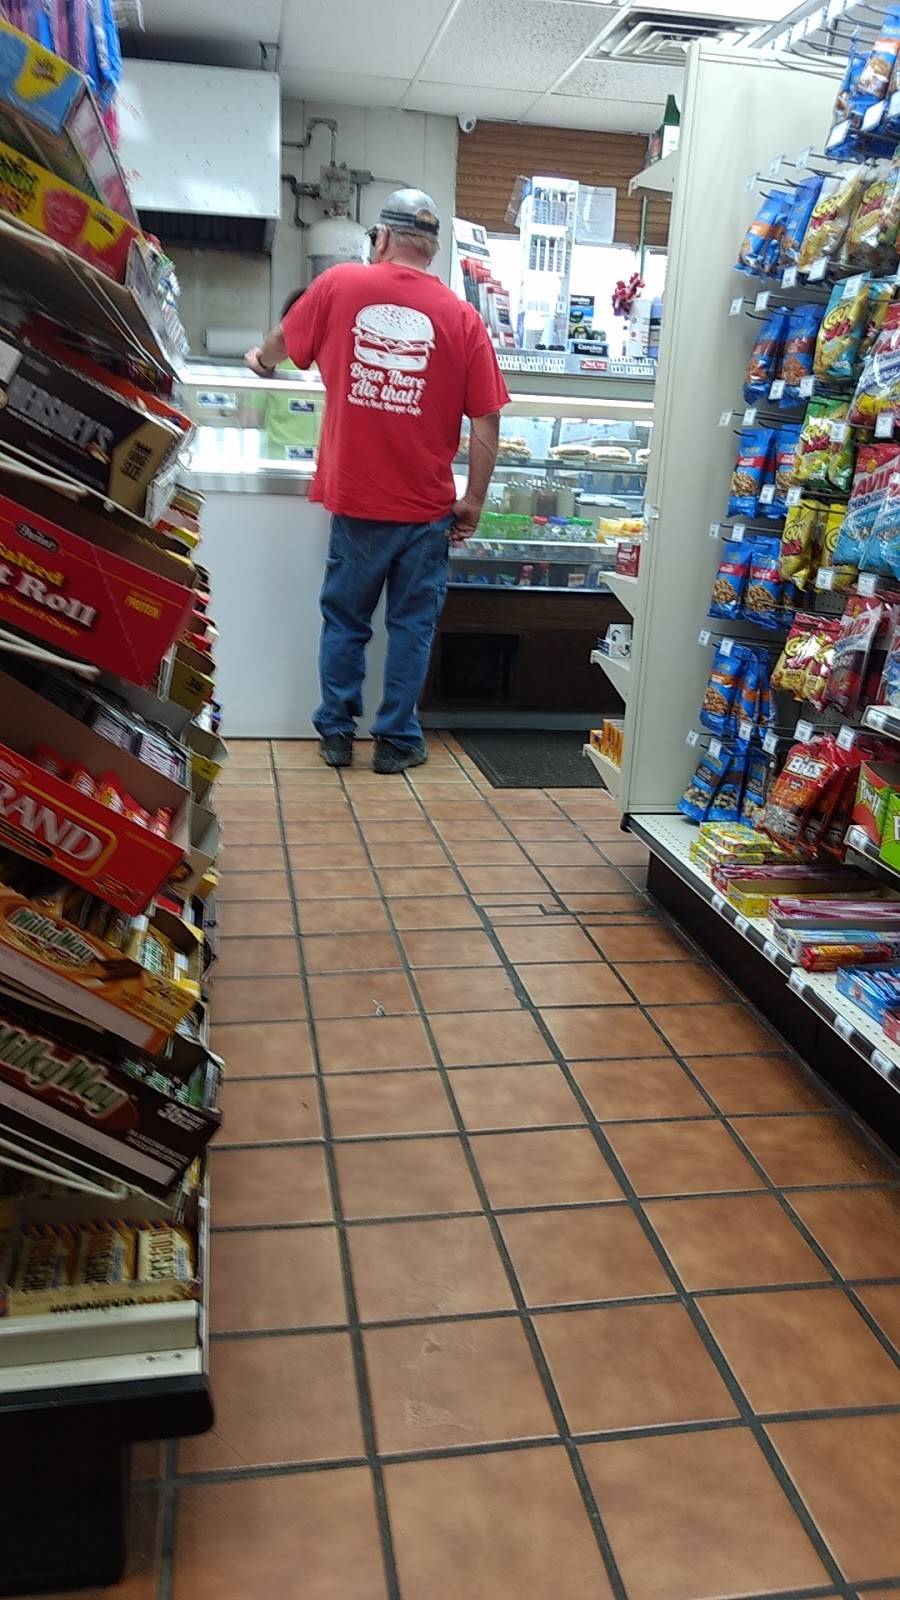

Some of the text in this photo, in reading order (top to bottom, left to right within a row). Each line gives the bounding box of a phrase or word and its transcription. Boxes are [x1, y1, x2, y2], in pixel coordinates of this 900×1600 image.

[350, 362, 427, 391] Been There
[351, 380, 379, 399] Ate
[380, 385, 422, 406] that!
[15, 571, 97, 628] Roll
[54, 1055, 130, 1119] Way
